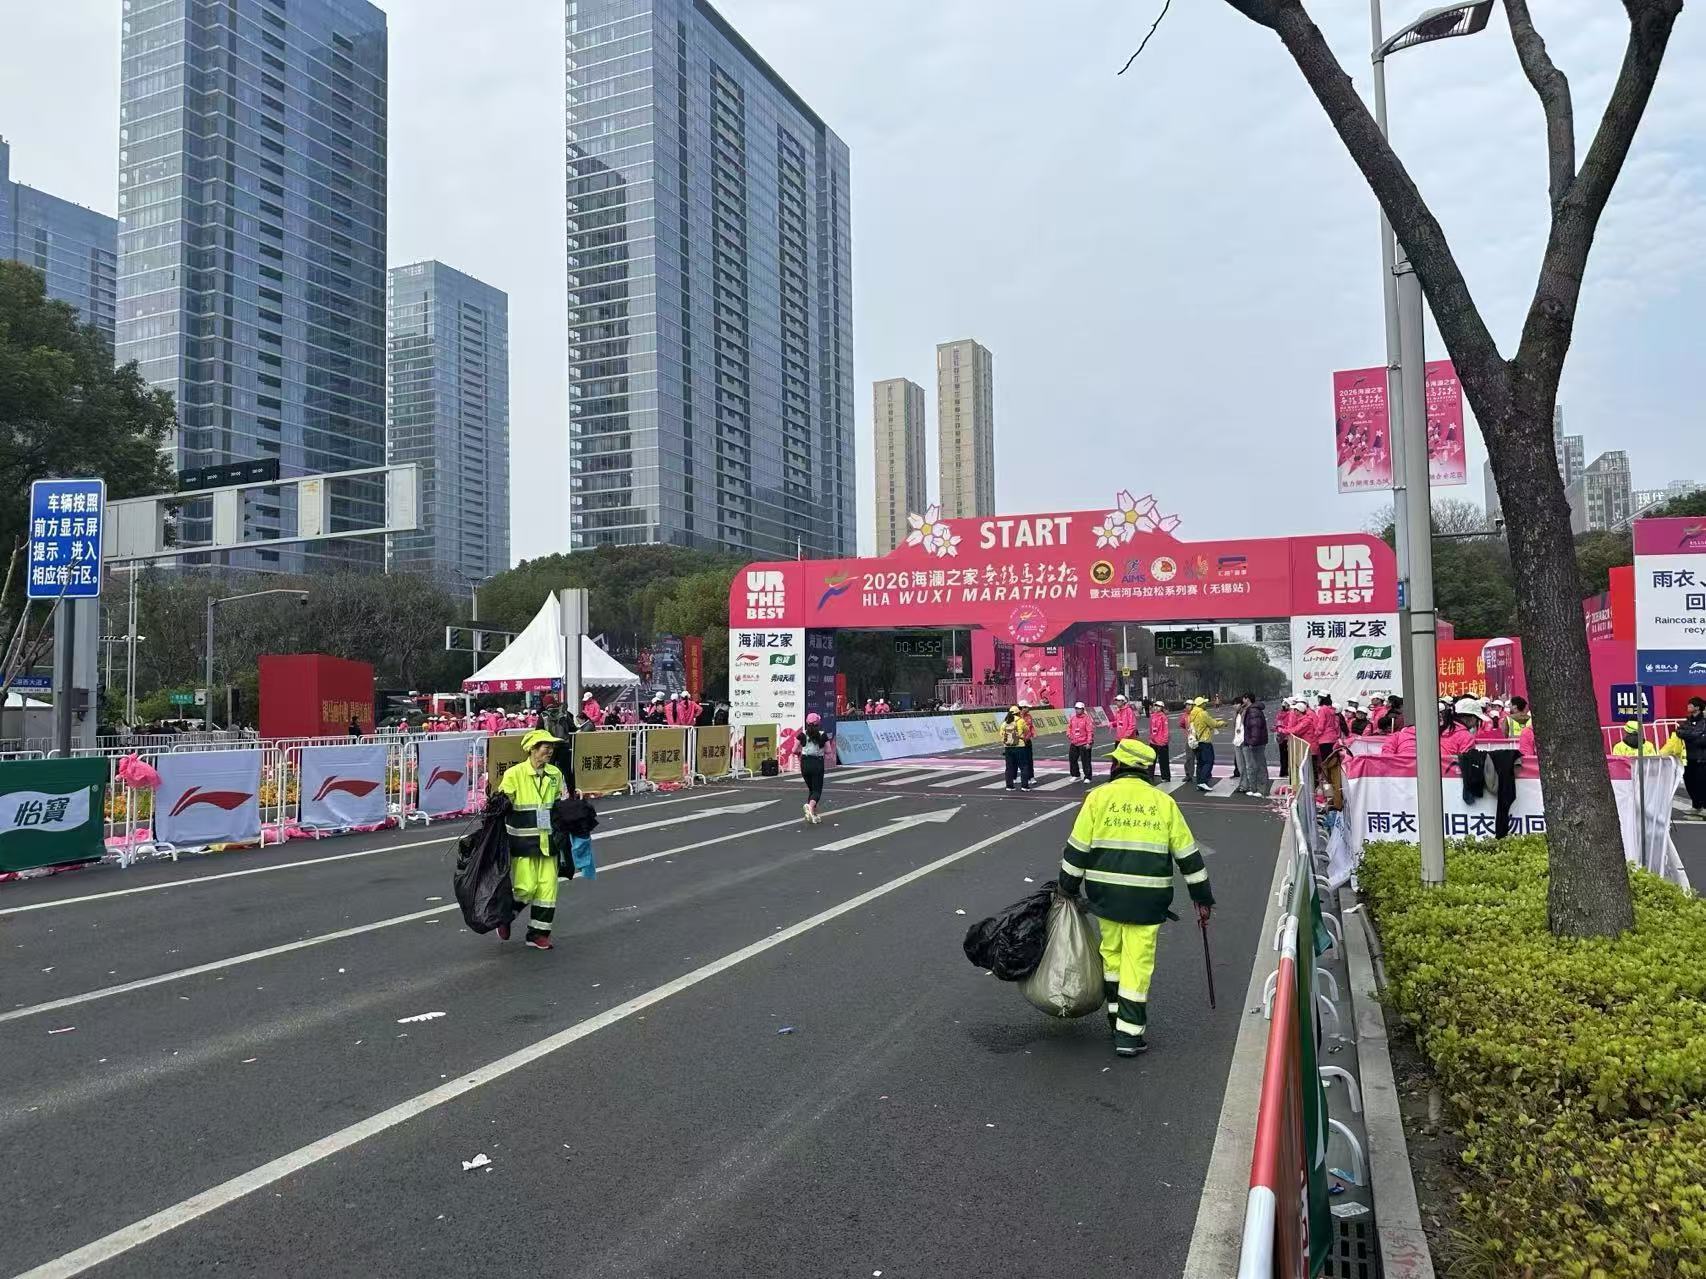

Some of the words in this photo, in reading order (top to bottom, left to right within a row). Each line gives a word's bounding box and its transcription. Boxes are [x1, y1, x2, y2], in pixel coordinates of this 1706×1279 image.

[48, 493, 98, 513] 车辆按照
[34, 517, 98, 537] 前方显示屏
[980, 517, 1072, 549] START
[1317, 544, 1373, 570] UR
[747, 571, 785, 591] UR
[863, 568, 979, 591] 2026海澜之家
[1121, 574, 1146, 584] AIMS
[1317, 570, 1374, 588] THE
[747, 592, 785, 607] THE
[863, 592, 890, 606] HLA
[899, 588, 953, 604] WUXI
[962, 583, 1079, 602] MARATHON
[1318, 589, 1374, 605] BEST
[747, 607, 785, 620] BEST
[1655, 616, 1697, 625] Raincoat
[1307, 620, 1387, 639] 海澜之家
[738, 633, 793, 648] 海澜之家
[1157, 636, 1213, 650] 00:15:52
[1617, 692, 1648, 706] HLA
[581, 753, 622, 771] 海澜之家
[651, 748, 681, 764] 海澜之家
